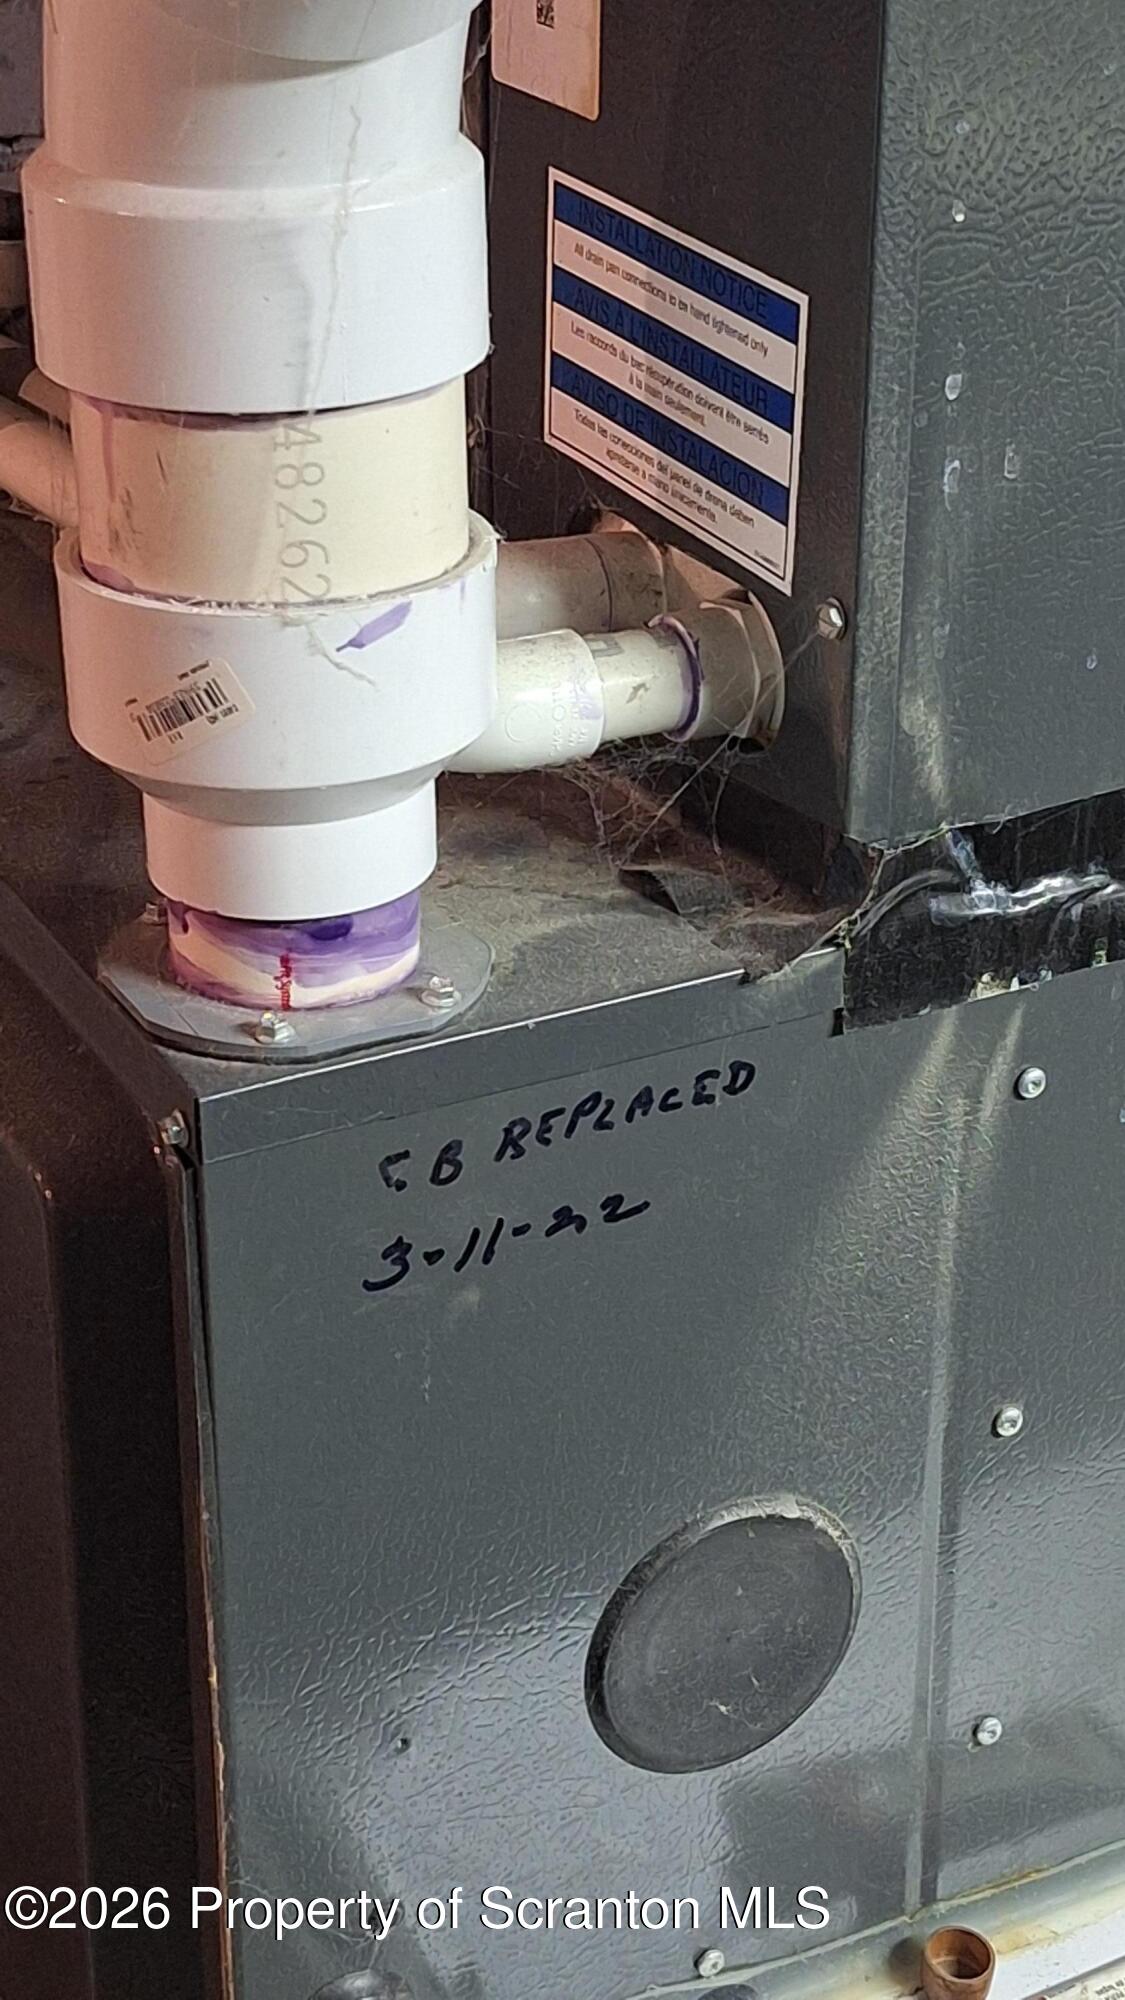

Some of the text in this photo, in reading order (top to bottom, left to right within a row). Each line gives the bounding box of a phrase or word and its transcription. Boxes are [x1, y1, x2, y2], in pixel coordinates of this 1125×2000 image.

[578, 199, 768, 320] INSTALLATION NOTICE
[574, 285, 609, 326] AVIS
[750, 335, 767, 358] only
[573, 372, 617, 419] AVISO
[623, 402, 645, 436] DE
[494, 1060, 756, 1163] REPLACED
[361, 1194, 651, 1292] 3-11-22
